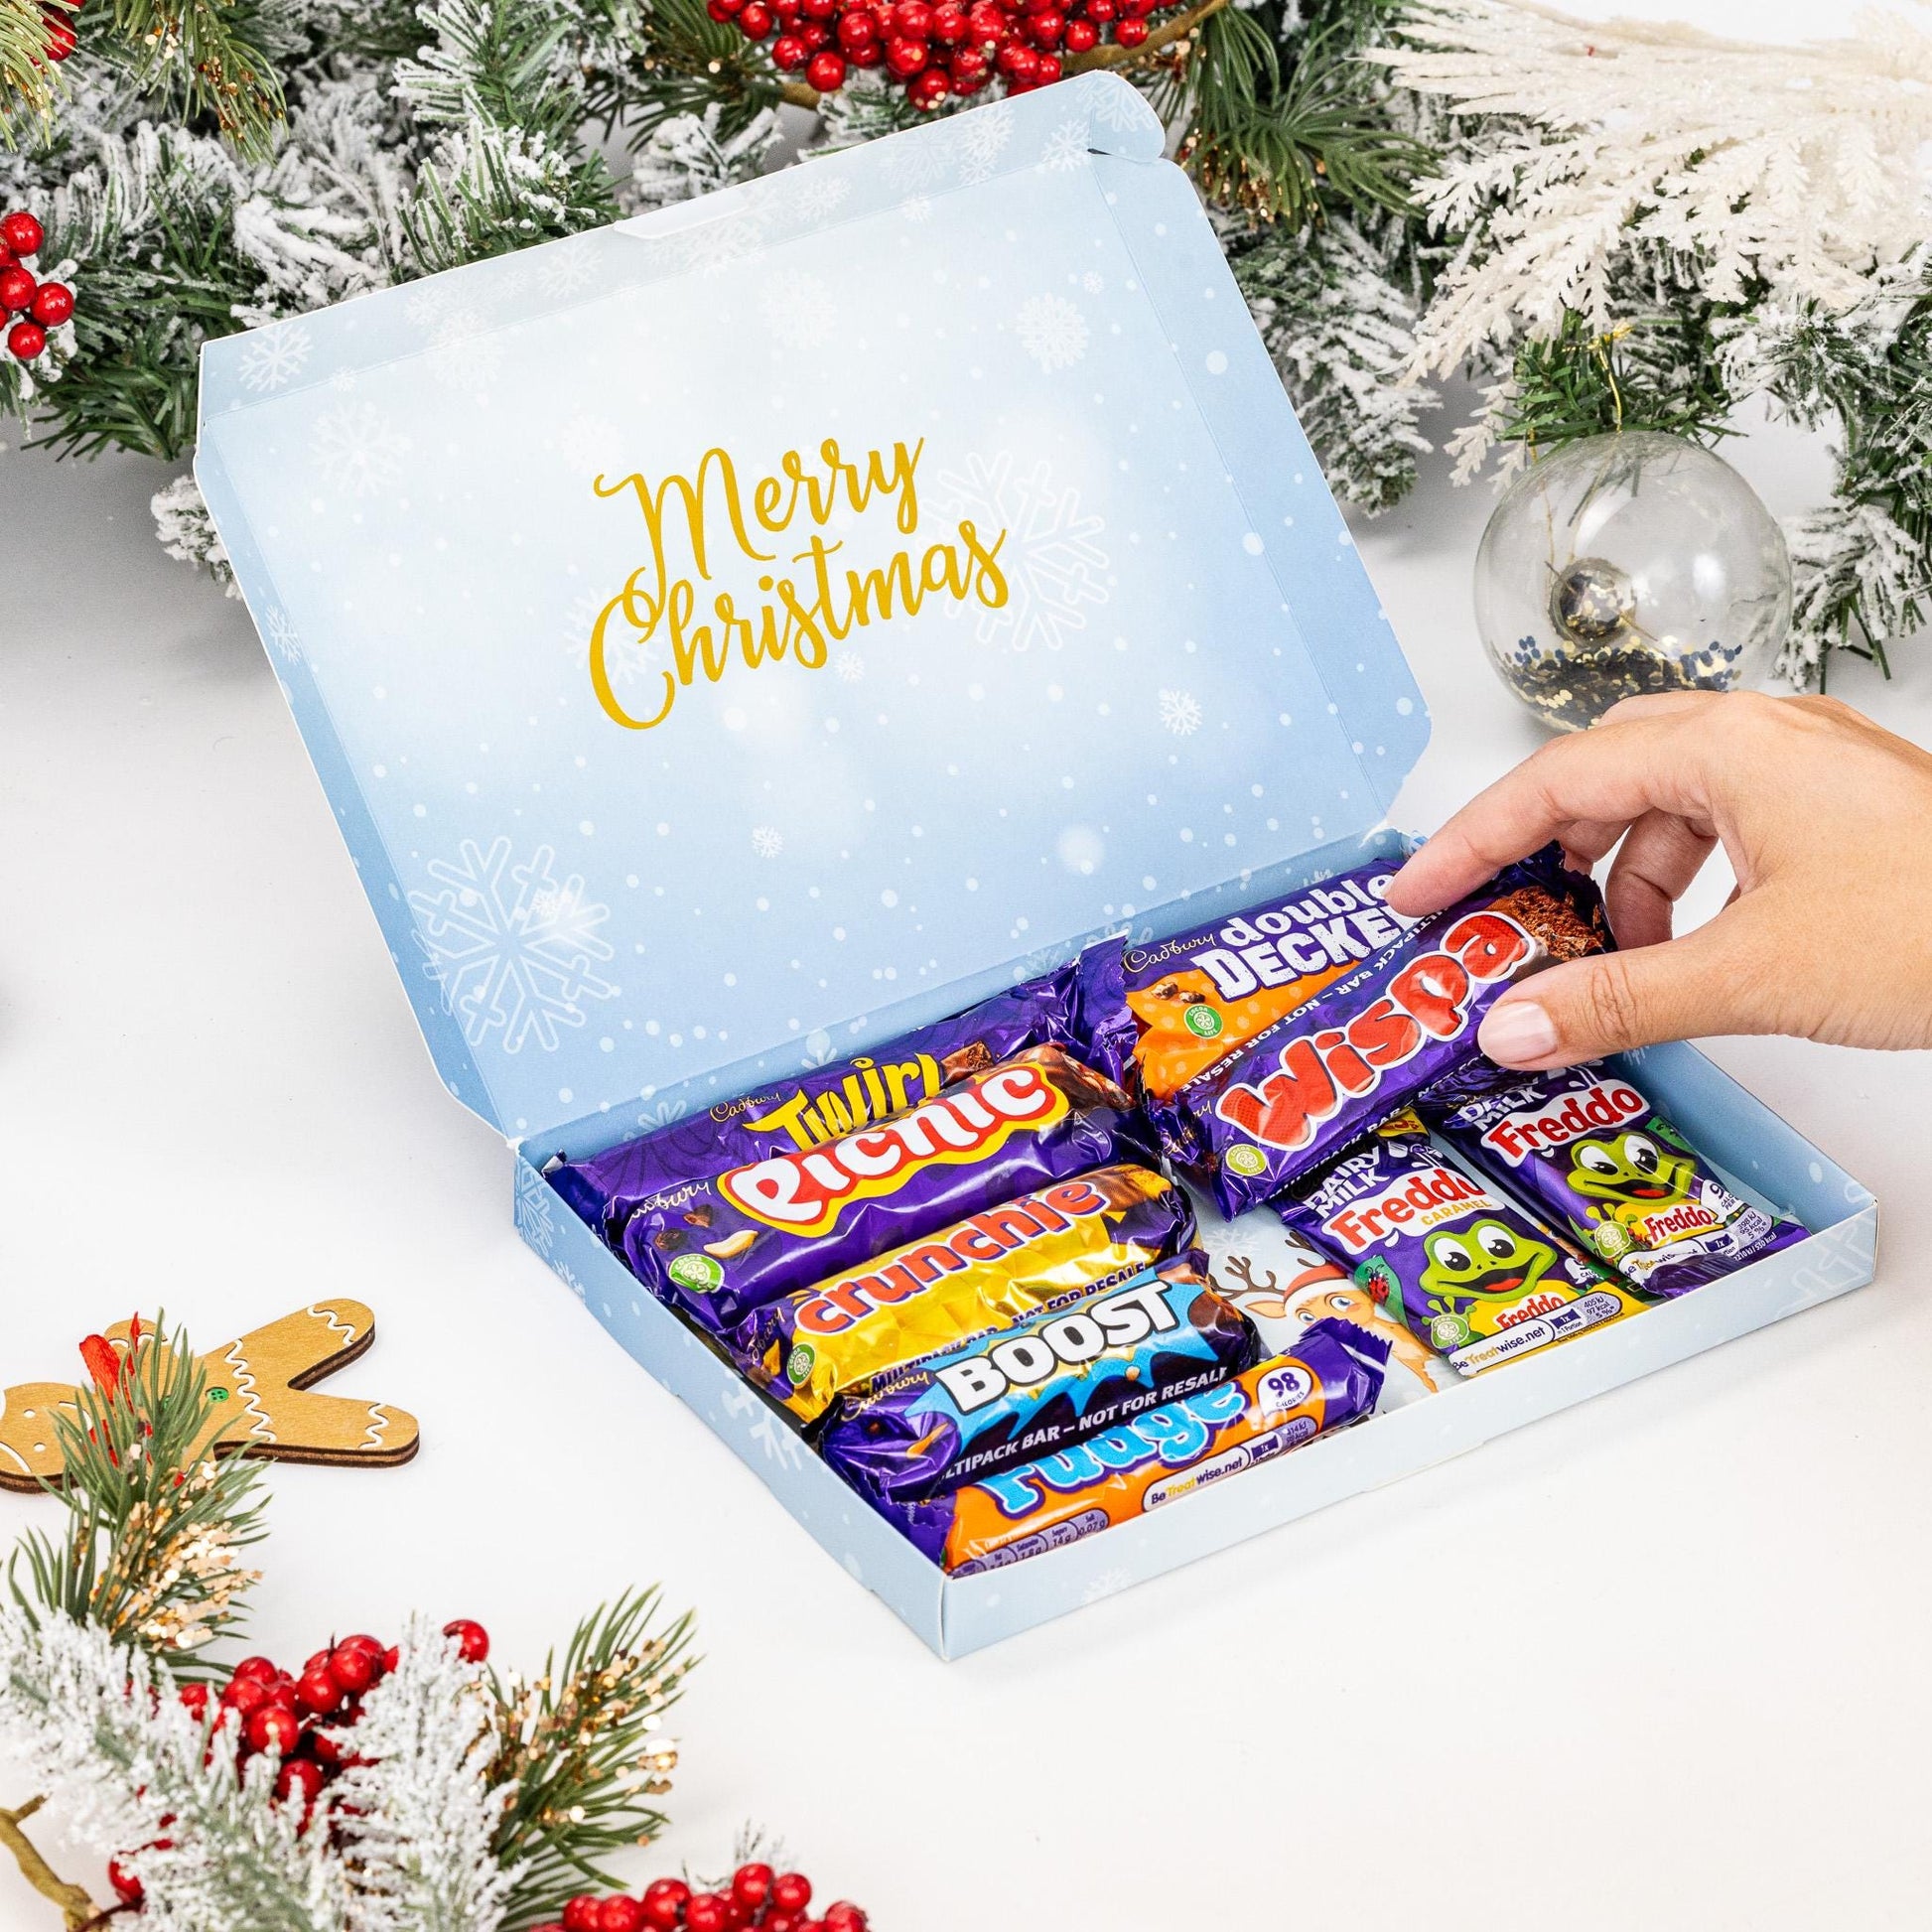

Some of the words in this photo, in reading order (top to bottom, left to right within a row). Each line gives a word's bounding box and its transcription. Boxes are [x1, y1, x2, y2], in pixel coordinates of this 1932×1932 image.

[593, 437, 924, 640] Merry
[589, 519, 1009, 730] Christmas
[1123, 932, 1216, 973] Cadbury
[1338, 970, 1374, 995] BAR
[1217, 911, 1534, 1150] Wispa
[1284, 999, 1321, 1026] NOT
[1245, 1025, 1282, 1048] FOR
[709, 1092, 782, 1123] Cadbury
[1489, 1086, 1644, 1160] Freddo
[1316, 1168, 1390, 1220] MILK
[1421, 1199, 1492, 1227] CARAMEL
[1644, 1206, 1713, 1243] Freddo
[794, 1182, 1109, 1333] crunchie
[935, 1280, 1179, 1414] BOOST
[1268, 1372, 1301, 1398] 98
[1022, 1426, 1060, 1451] BAR
[1078, 1408, 1120, 1433] NOT
[1121, 1394, 1158, 1418] FOR
